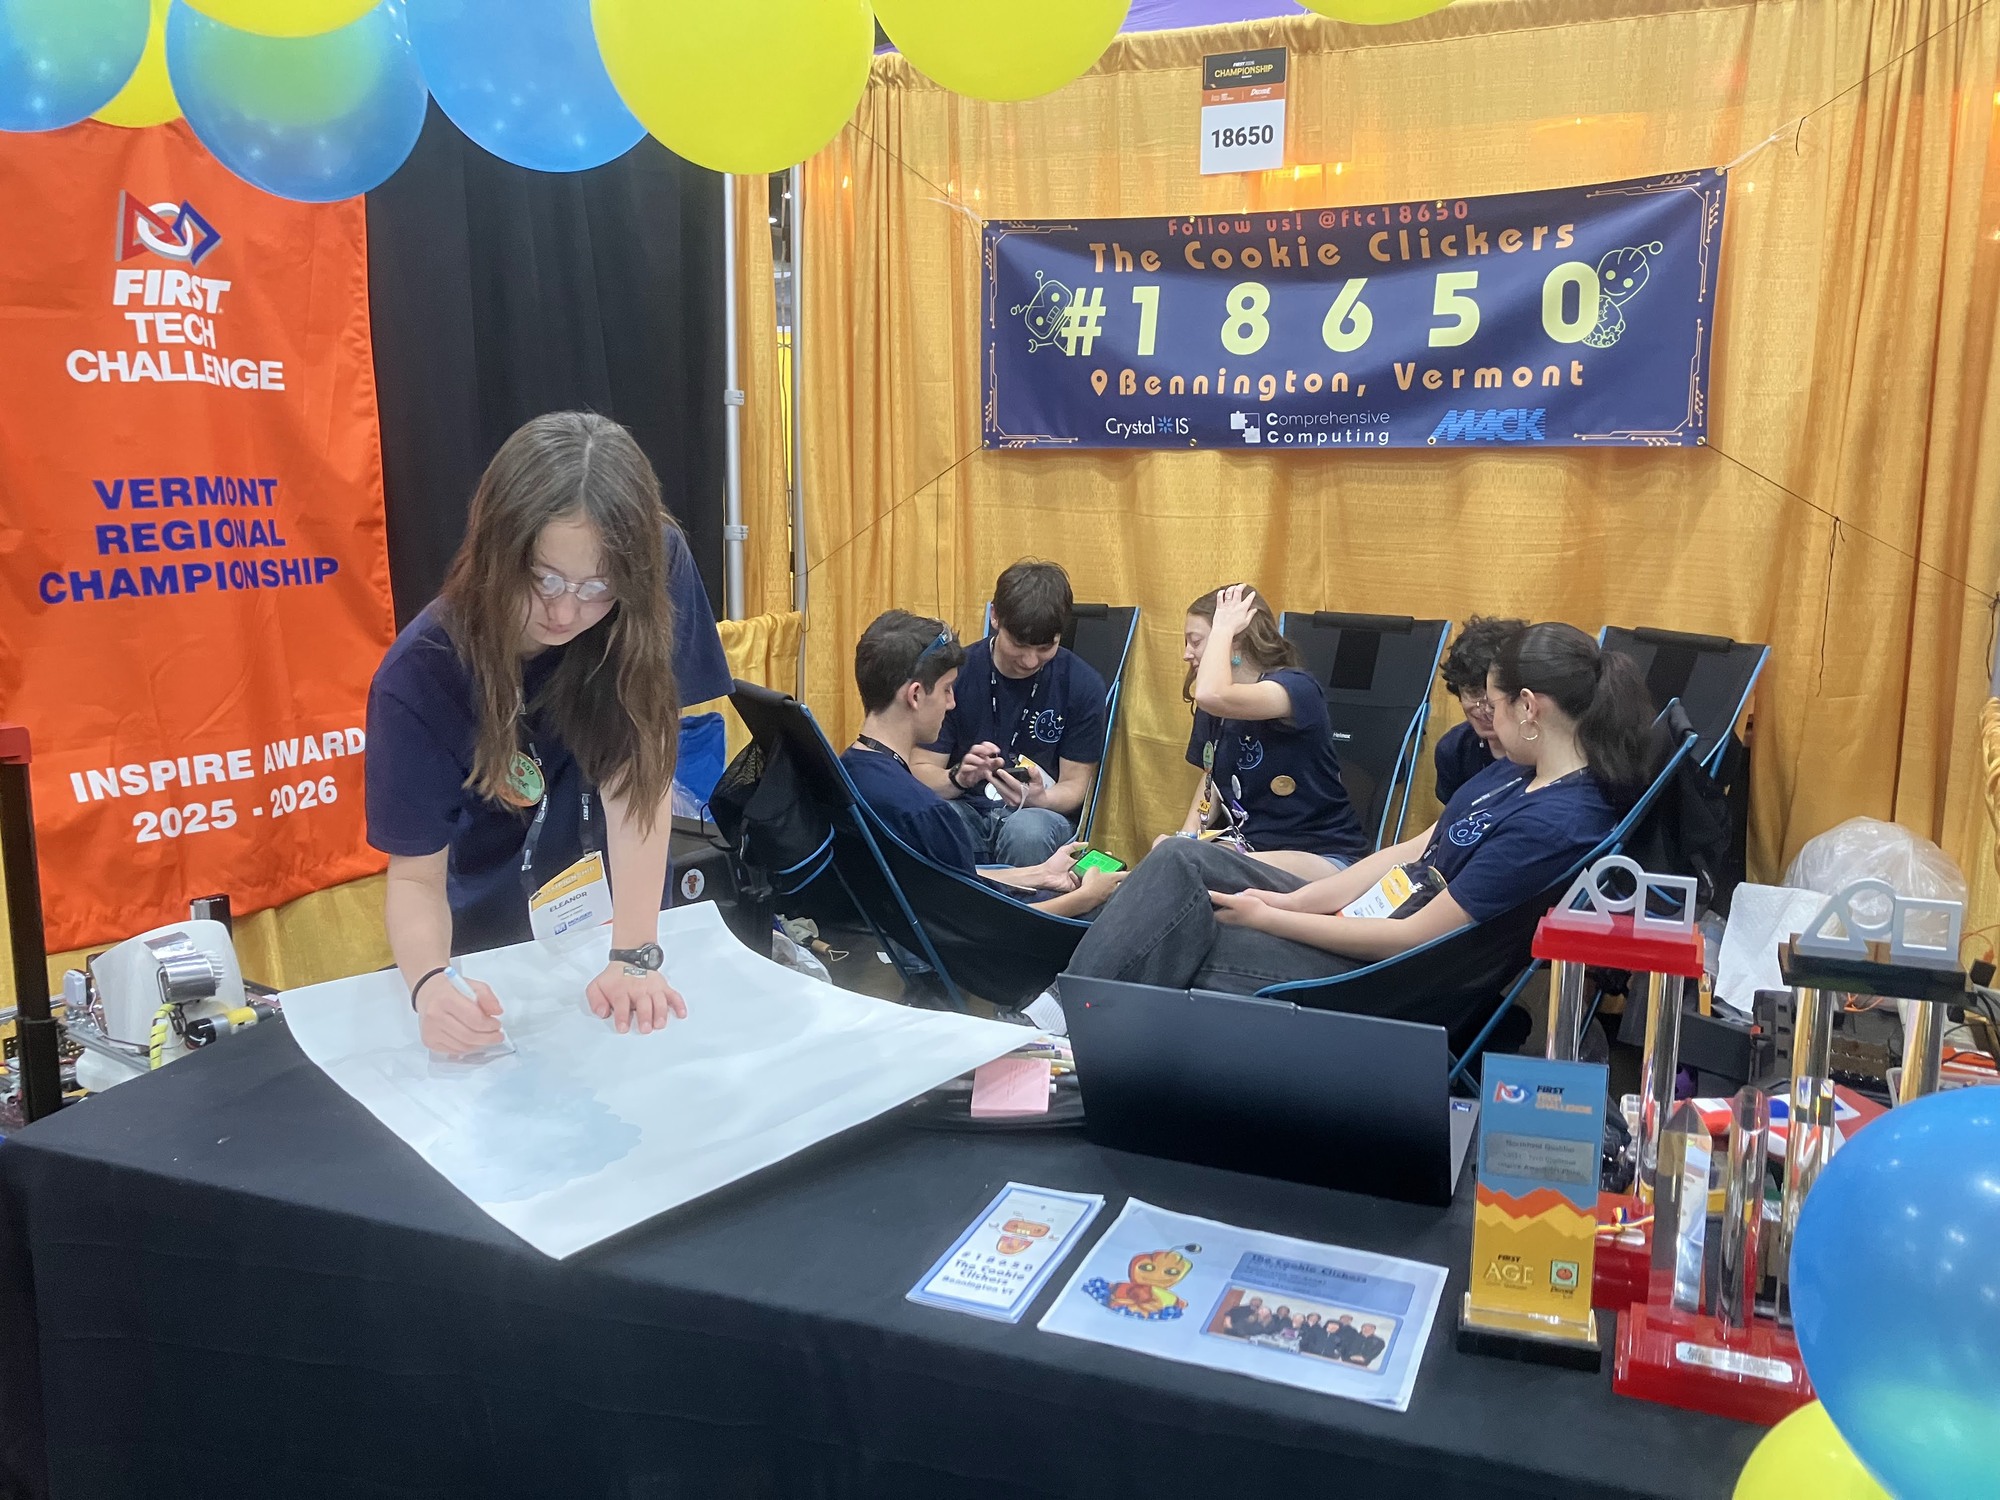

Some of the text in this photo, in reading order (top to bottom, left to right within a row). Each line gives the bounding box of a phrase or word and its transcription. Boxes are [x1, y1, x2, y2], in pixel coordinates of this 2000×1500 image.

[1214, 64, 1274, 78] CHAMPIONSHIP
[1211, 124, 1274, 148] 18650
[1266, 212, 1302, 231] us!
[1318, 200, 1468, 229] @ftc18650
[1089, 223, 1574, 273] The Cookie Clickers
[113, 269, 231, 314] FIRST
[125, 312, 217, 349] TECH
[66, 349, 285, 391] CHALLENGE
[1119, 360, 1584, 401] Bennington, Vermont
[1105, 416, 1155, 439] Crystal
[1266, 410, 1390, 427] Comprehensive
[1267, 428, 1390, 446] Computing
[92, 475, 278, 511] VERMONT
[95, 518, 286, 555] REGIONAL
[39, 556, 339, 605] CHAMPIONSHIP
[69, 727, 366, 803] INSPIRE AWARD
[132, 798, 237, 844] 2025
[270, 775, 338, 819] 2026
[549, 891, 588, 912] ELEANOR
[1536, 1085, 1565, 1095] FIRST
[1484, 1262, 1534, 1284] AGE
[1498, 1254, 1521, 1262] FIRST
